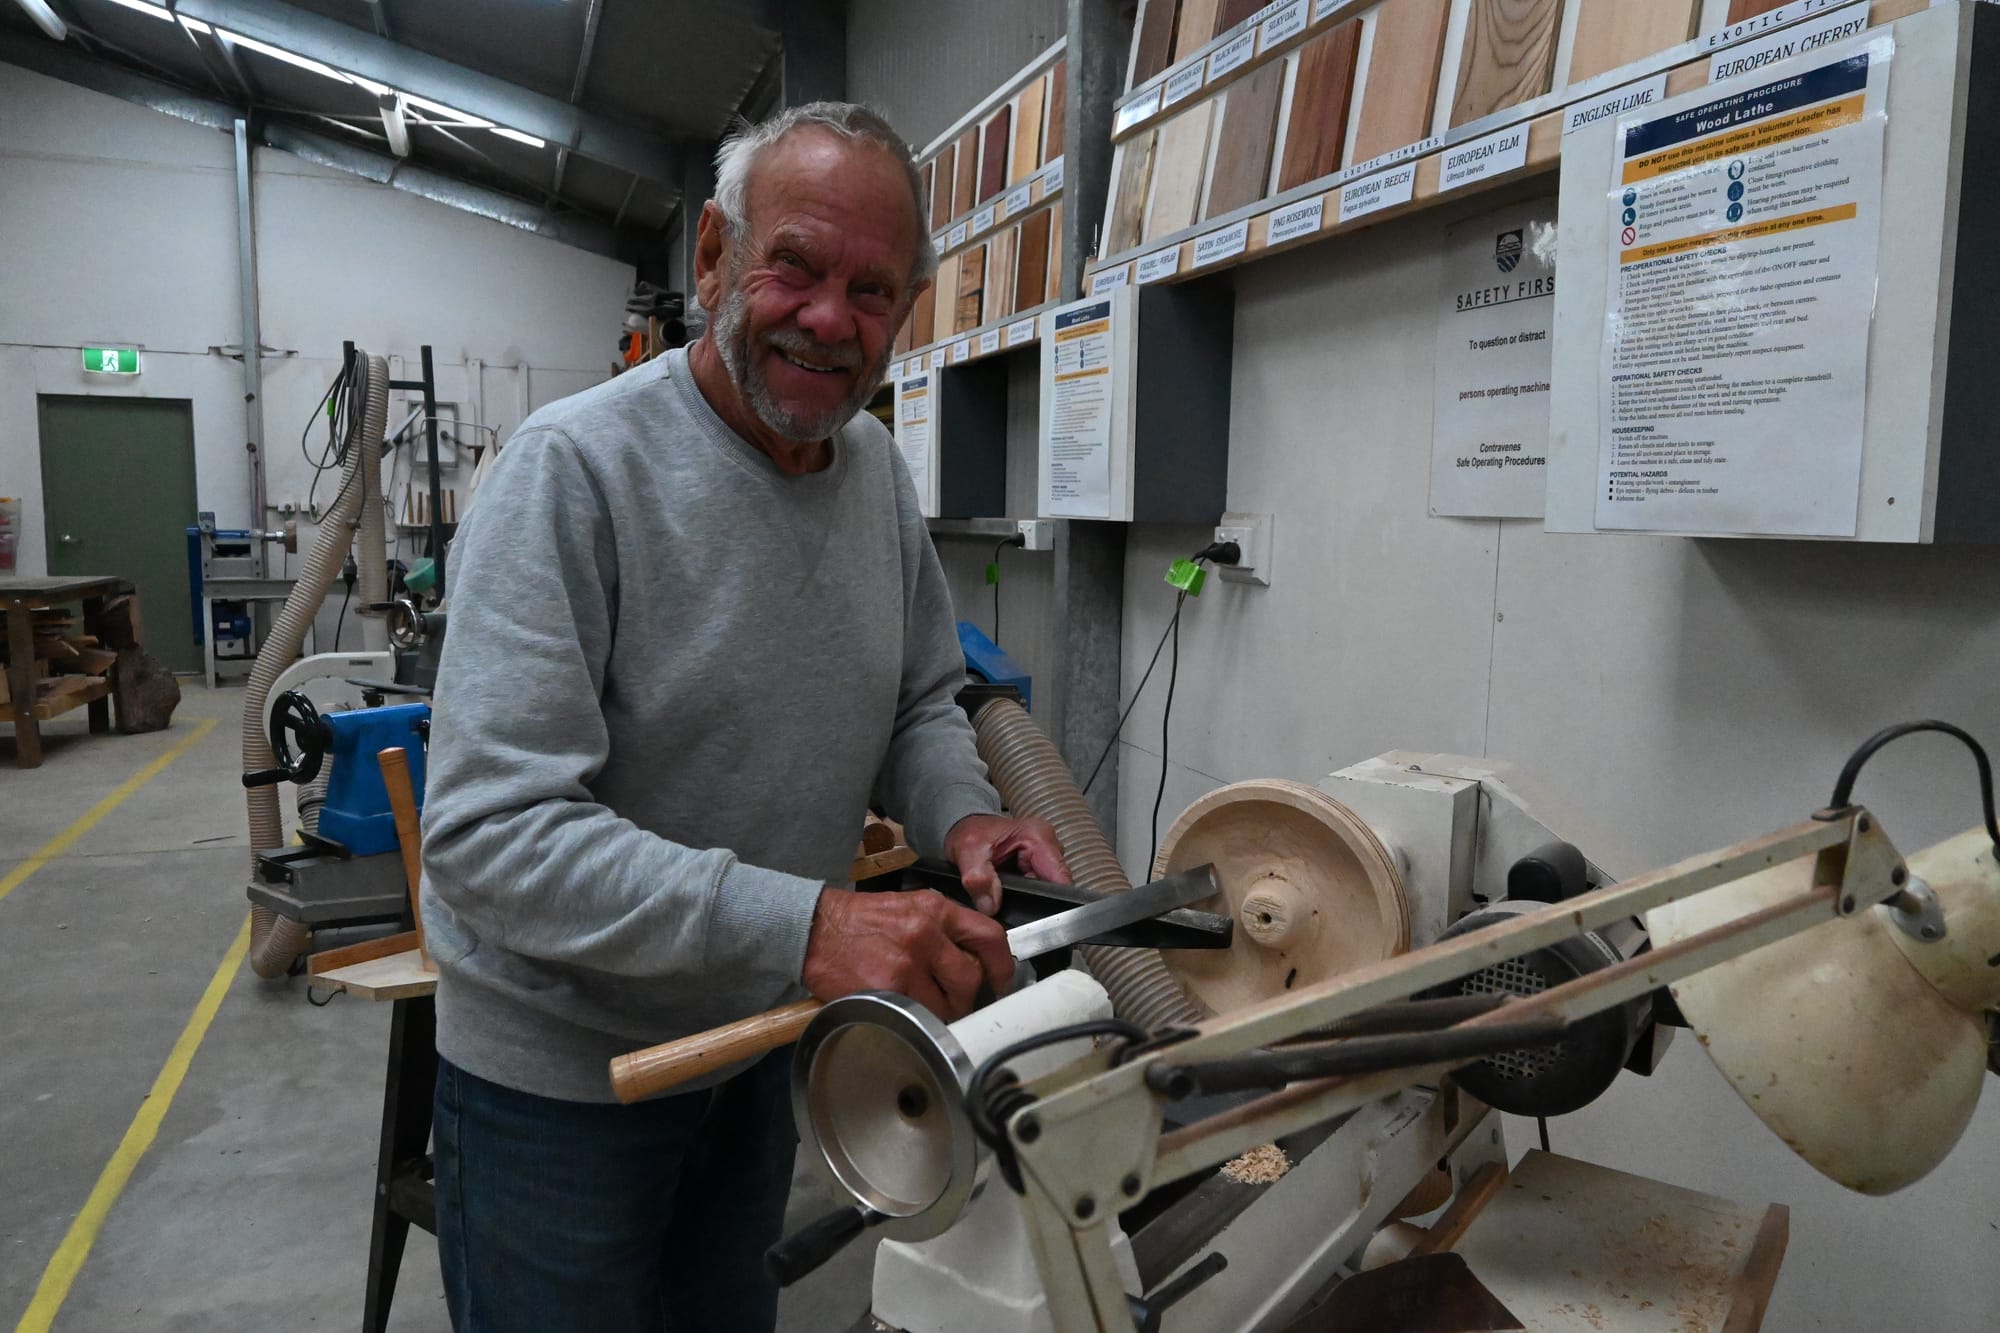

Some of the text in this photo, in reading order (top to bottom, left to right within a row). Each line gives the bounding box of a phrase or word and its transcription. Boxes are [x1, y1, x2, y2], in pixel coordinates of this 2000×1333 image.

[1709, 11, 1784, 47] EXOTIC
[1715, 17, 1865, 81] EUROPEAN CHERRY
[1571, 88, 1655, 129] ENGLISH LIME
[1674, 76, 1803, 124] SAFE OPERATING PROCEDURE
[1696, 99, 1774, 132] Wood Lathe
[1638, 158, 1650, 168] DO
[1650, 153, 1667, 165] NOT
[1695, 137, 1724, 152] machine
[1725, 130, 1750, 144] unless
[1757, 117, 1794, 135] Volunteer
[1796, 109, 1824, 124] Leader
[1826, 104, 1842, 116] has
[1725, 144, 1740, 156] safe
[1741, 140, 1754, 152] use
[1757, 136, 1771, 148] and
[1343, 136, 1440, 179] EXOTIC TIMBERS
[1447, 134, 1520, 171] EUROPEAN ELM
[1813, 155, 1840, 170] clothing
[1446, 162, 1485, 183] Ulmus laevis
[1344, 171, 1411, 202] EUROPEAN BEECH
[1770, 188, 1799, 202] protection
[1272, 203, 1322, 230] PNG ROSEWOOD
[1741, 223, 1768, 237] machine
[1777, 218, 1791, 229] any
[1792, 215, 1805, 226] one
[1620, 246, 1727, 273] PRE-OPERATIONAL SAFETY CHECKS
[1456, 275, 1555, 310] SAFETY FIRS
[1469, 330, 1546, 351] To question or distract
[1611, 366, 1702, 382] OPERATIONAL SAFETY CHECKS
[1776, 375, 1803, 384] complete
[1458, 381, 1551, 402] persons operating machine
[1611, 425, 1654, 434] HOUSEKEEPING
[1479, 441, 1521, 454] Contravenes
[1456, 455, 1546, 470] Safe Operating Procedures
